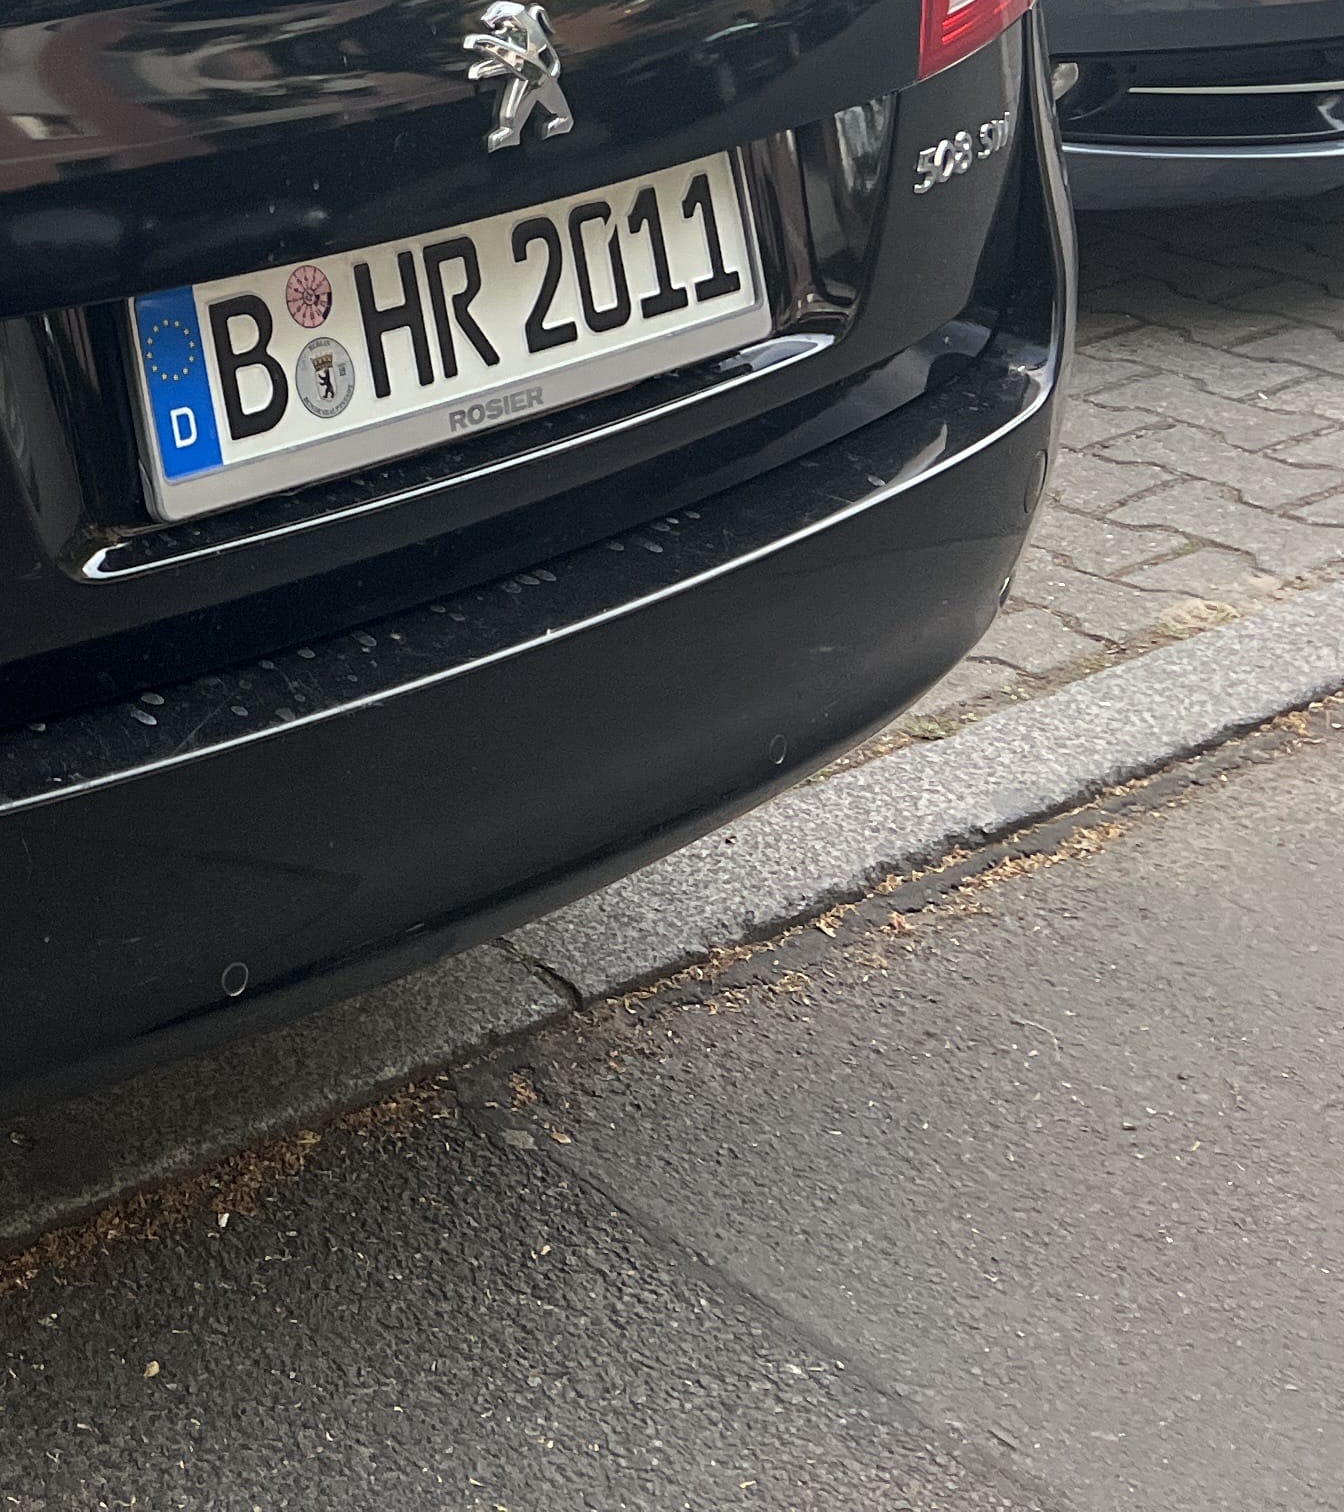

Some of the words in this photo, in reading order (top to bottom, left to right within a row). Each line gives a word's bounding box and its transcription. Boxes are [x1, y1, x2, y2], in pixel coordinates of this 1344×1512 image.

[913, 131, 972, 194] 508
[209, 294, 289, 441] B
[354, 236, 500, 399] HR
[513, 173, 741, 354] 2011
[170, 406, 198, 448] D
[449, 388, 544, 433] ROSIER
